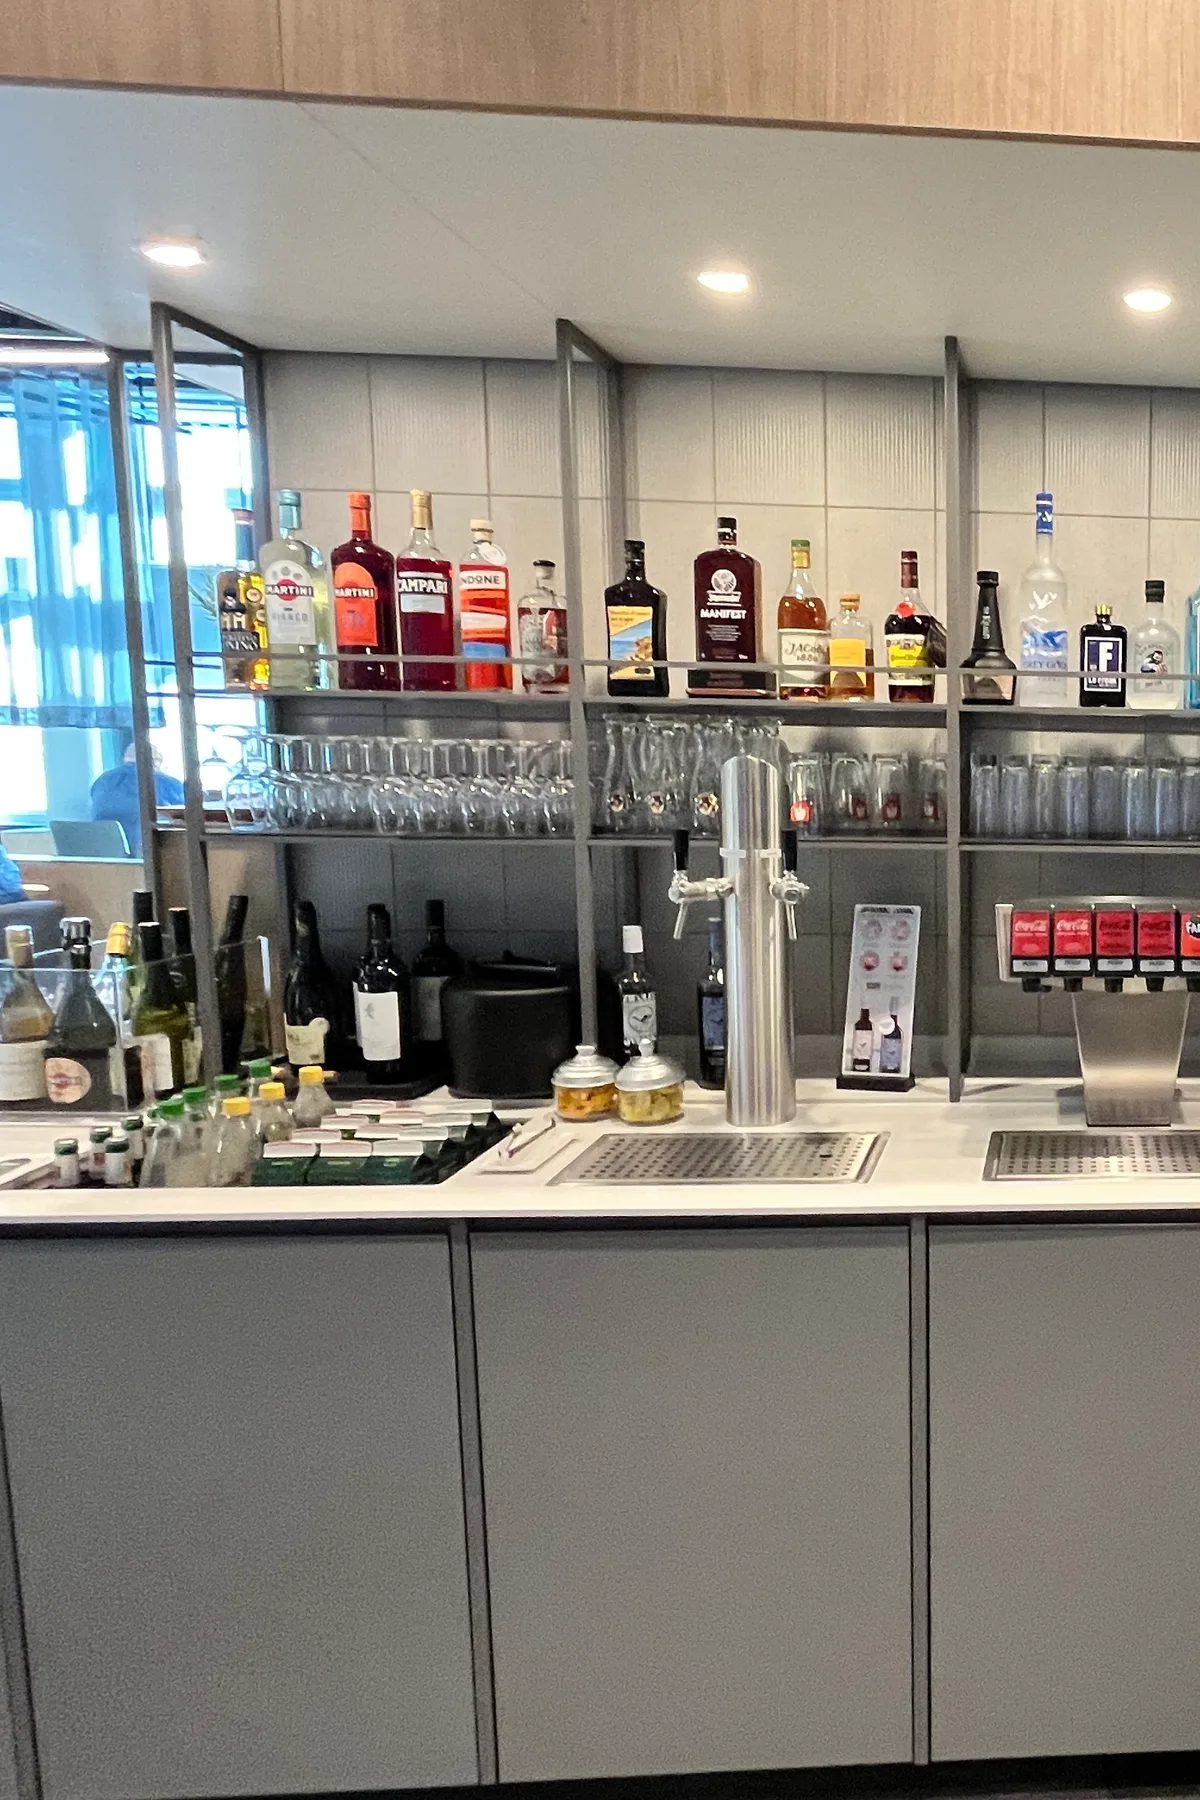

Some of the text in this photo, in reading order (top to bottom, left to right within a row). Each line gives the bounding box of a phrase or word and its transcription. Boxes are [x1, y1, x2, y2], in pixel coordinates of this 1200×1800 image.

[460, 575, 500, 585] NDONE
[266, 585, 313, 596] MARTINI
[398, 578, 448, 594] CAMPARI
[335, 588, 374, 598] MARTINI
[700, 608, 747, 619] MANIFEST
